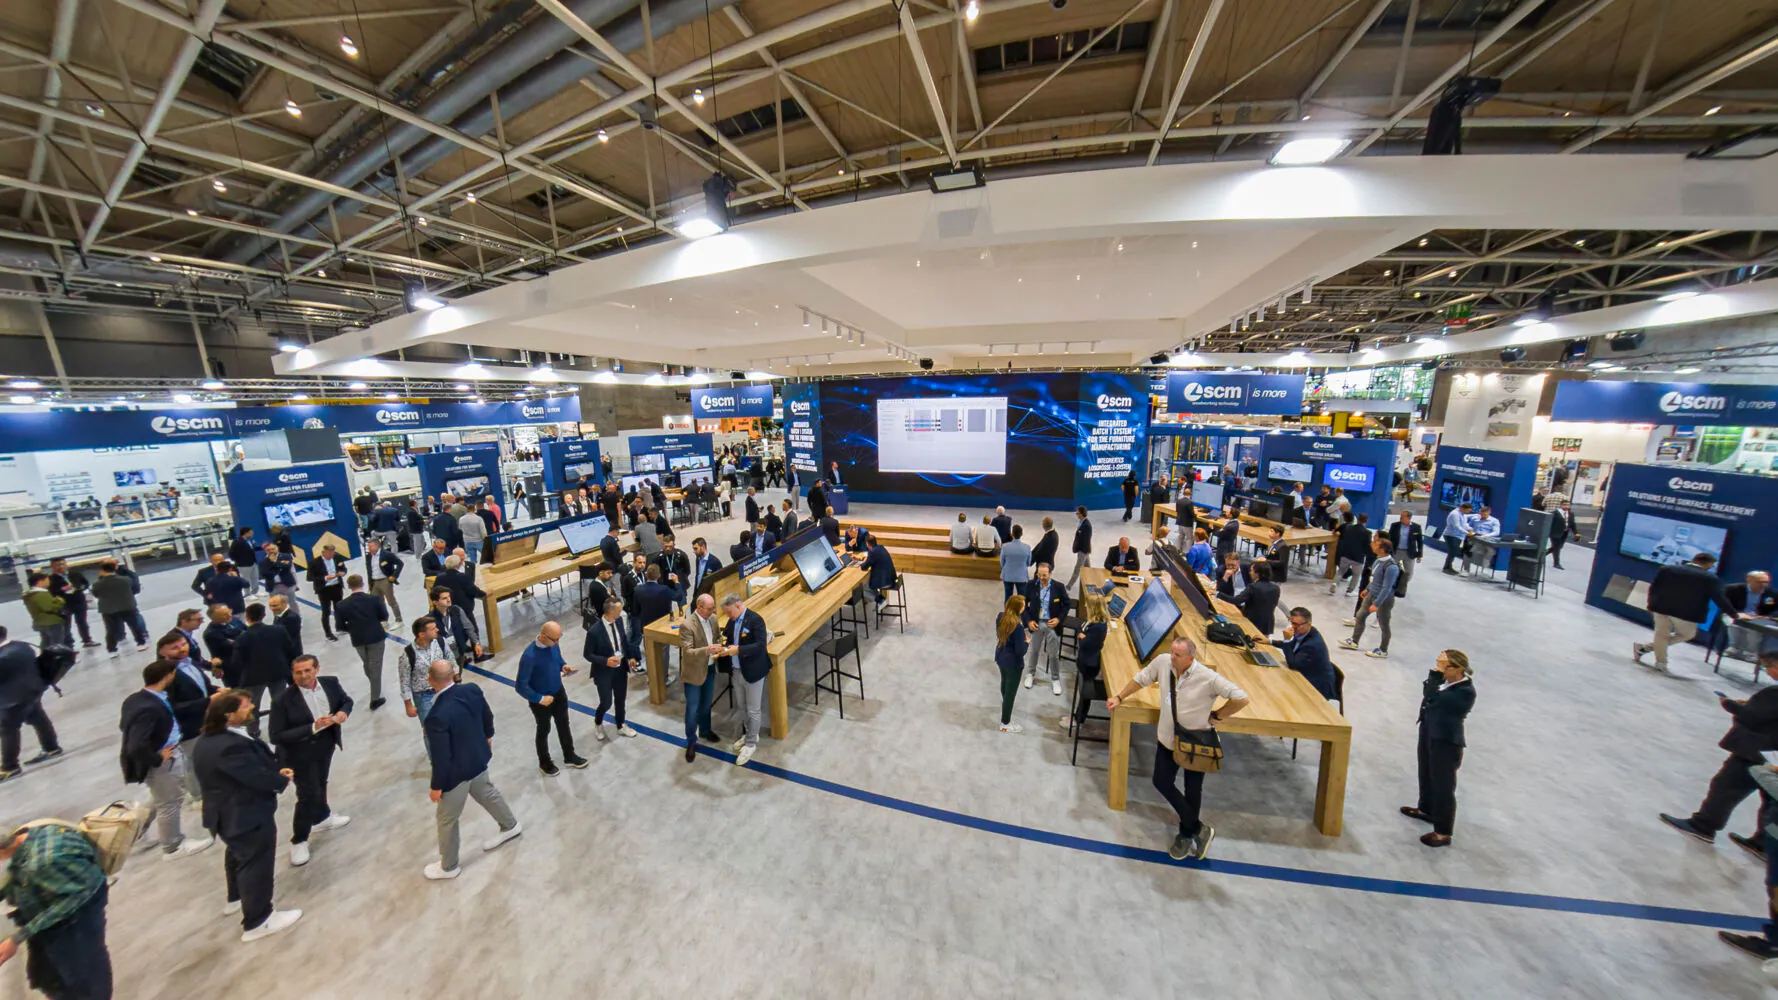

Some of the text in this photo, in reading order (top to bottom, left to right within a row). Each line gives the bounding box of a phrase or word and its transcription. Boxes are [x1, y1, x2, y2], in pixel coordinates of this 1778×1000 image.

[1204, 386, 1287, 399] scm is more
[712, 396, 734, 406] scm
[797, 402, 810, 411] scm
[1109, 396, 1132, 407] scm
[1682, 396, 1726, 409] scm
[1747, 401, 1776, 409] more
[391, 411, 419, 420] scm
[530, 407, 544, 415] scm
[176, 417, 223, 430] scm
[235, 418, 243, 426] is
[1342, 472, 1367, 481] scm
[1683, 480, 1714, 492] scm
[1628, 491, 1662, 502] SOLUTIONS
[1662, 496, 1677, 504] FOR
[1677, 498, 1709, 509] SURFACE
[1710, 503, 1757, 516] TREATMENT
